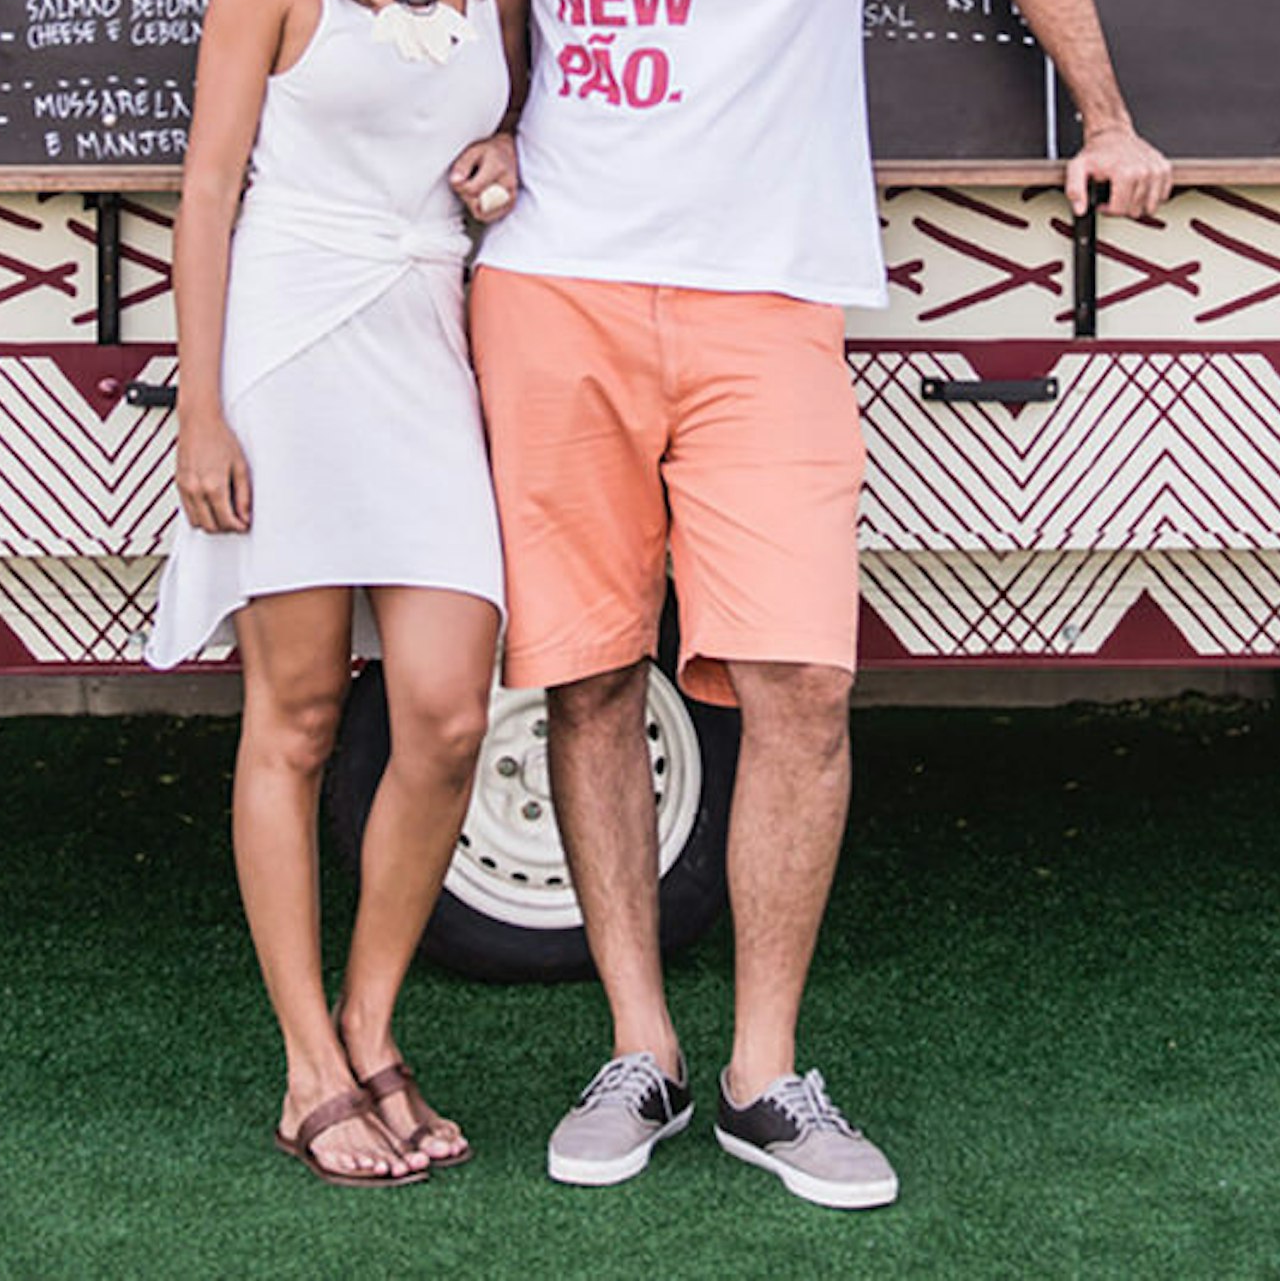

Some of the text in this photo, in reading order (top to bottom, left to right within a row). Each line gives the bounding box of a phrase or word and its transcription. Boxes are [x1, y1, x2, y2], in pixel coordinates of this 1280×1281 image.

[864, 5, 915, 28] SAL
[27, 21, 96, 49] CHEESE
[105, 20, 121, 41] E
[558, 34, 682, 109] PÃO.
[34, 89, 191, 118] MUSSARELA
[45, 128, 188, 160] E MANJER
